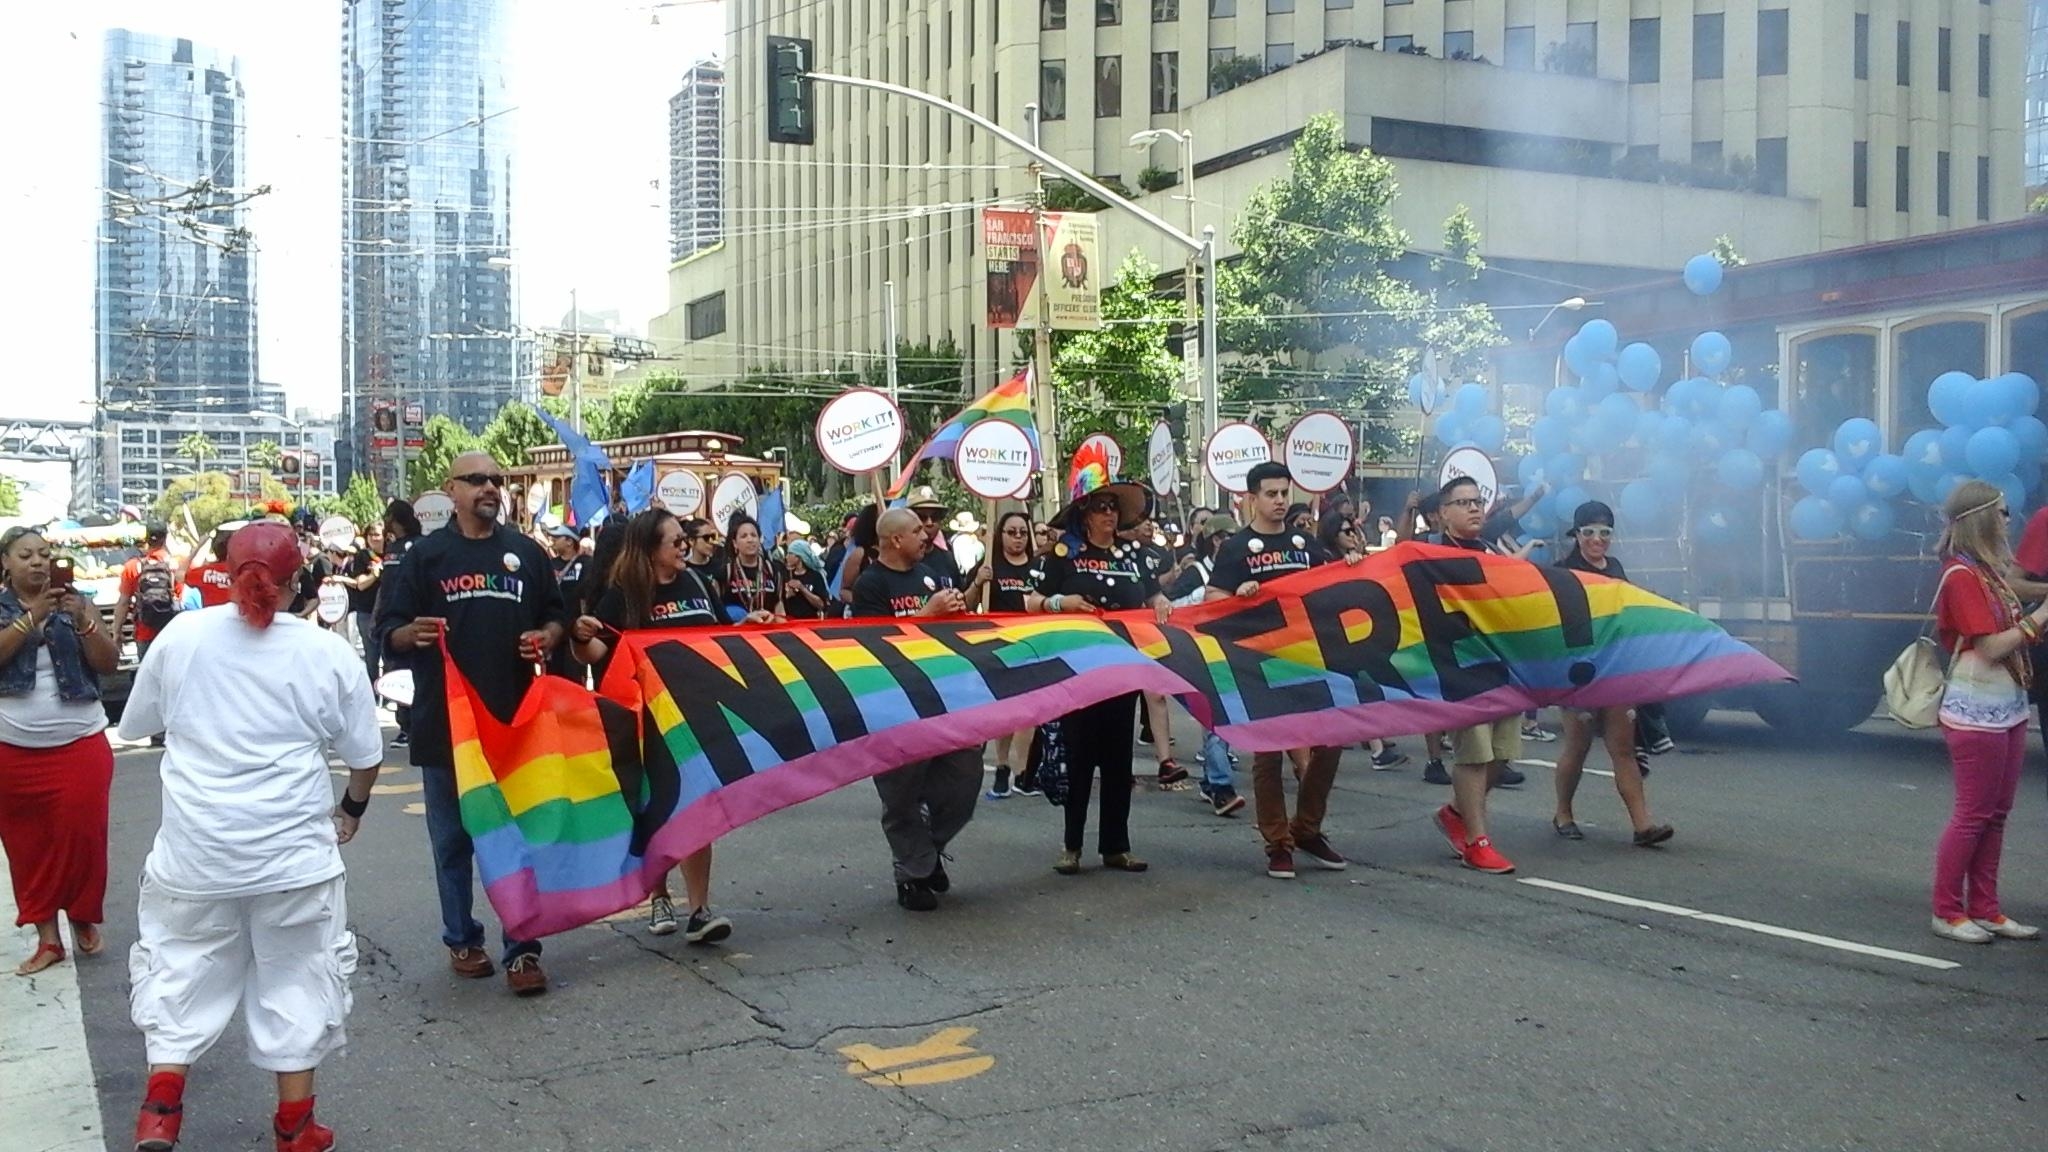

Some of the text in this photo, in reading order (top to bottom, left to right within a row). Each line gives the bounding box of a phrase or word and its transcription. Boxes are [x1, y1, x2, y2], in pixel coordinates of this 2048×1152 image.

[986, 218, 1004, 231] SAN
[987, 231, 1034, 245] FRANCISCO
[989, 246, 1019, 259] STARTS
[989, 260, 1010, 273] HERE
[826, 409, 896, 440] WORK IT!
[965, 446, 1028, 467] WORK IT!
[1212, 447, 1267, 461] WORK IT!
[1293, 439, 1349, 460] WORK IT!
[1074, 558, 1118, 571] WORK
[1247, 550, 1310, 570] WORK IT!
[440, 573, 523, 603] WORK IT!
[652, 600, 690, 616] ORK
[692, 598, 711, 611] IT!
[889, 594, 928, 610] WORK
